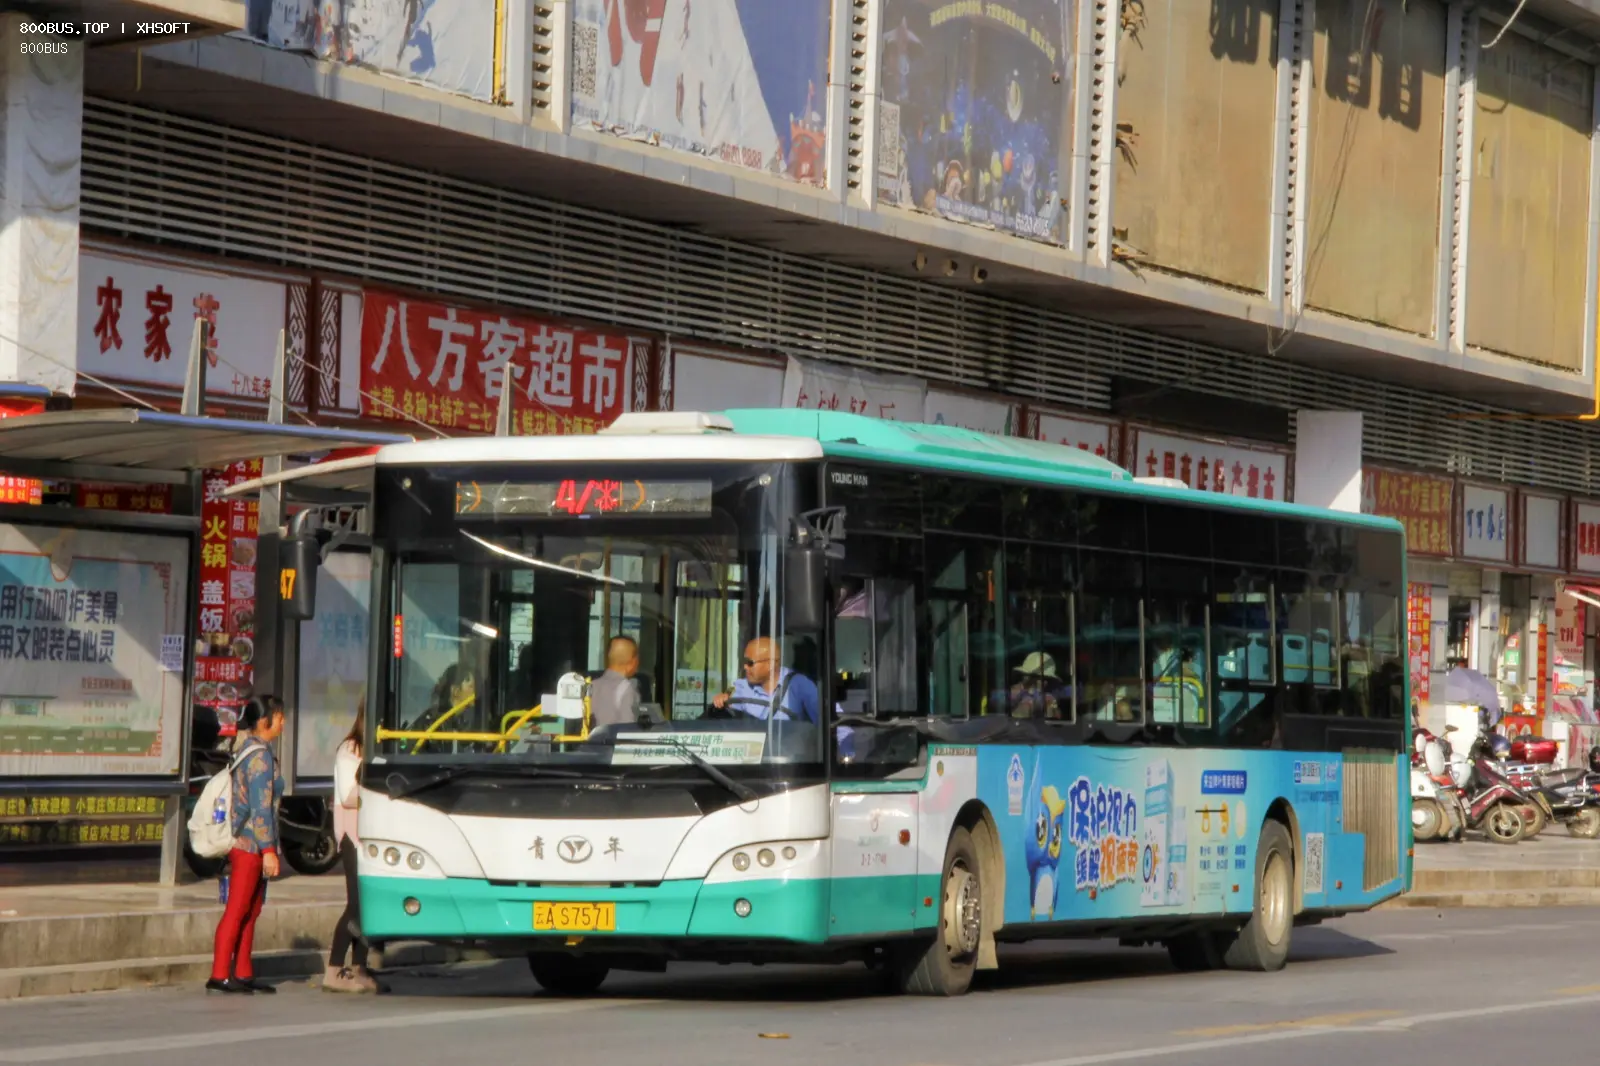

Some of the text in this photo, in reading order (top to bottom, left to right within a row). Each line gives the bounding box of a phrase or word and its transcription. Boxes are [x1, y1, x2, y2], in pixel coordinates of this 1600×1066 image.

[371, 302, 621, 414] 八方客超市
[831, 472, 868, 486] YOUNG MAN
[202, 515, 227, 568] 火锅
[200, 580, 225, 633] 盖饭
[0, 625, 115, 663] 用文明装点心灵
[1069, 779, 1137, 843] 保护视力
[528, 835, 624, 862] 青 年
[1076, 836, 1139, 886] 缓解视疲劳
[560, 906, 609, 926] S7571
